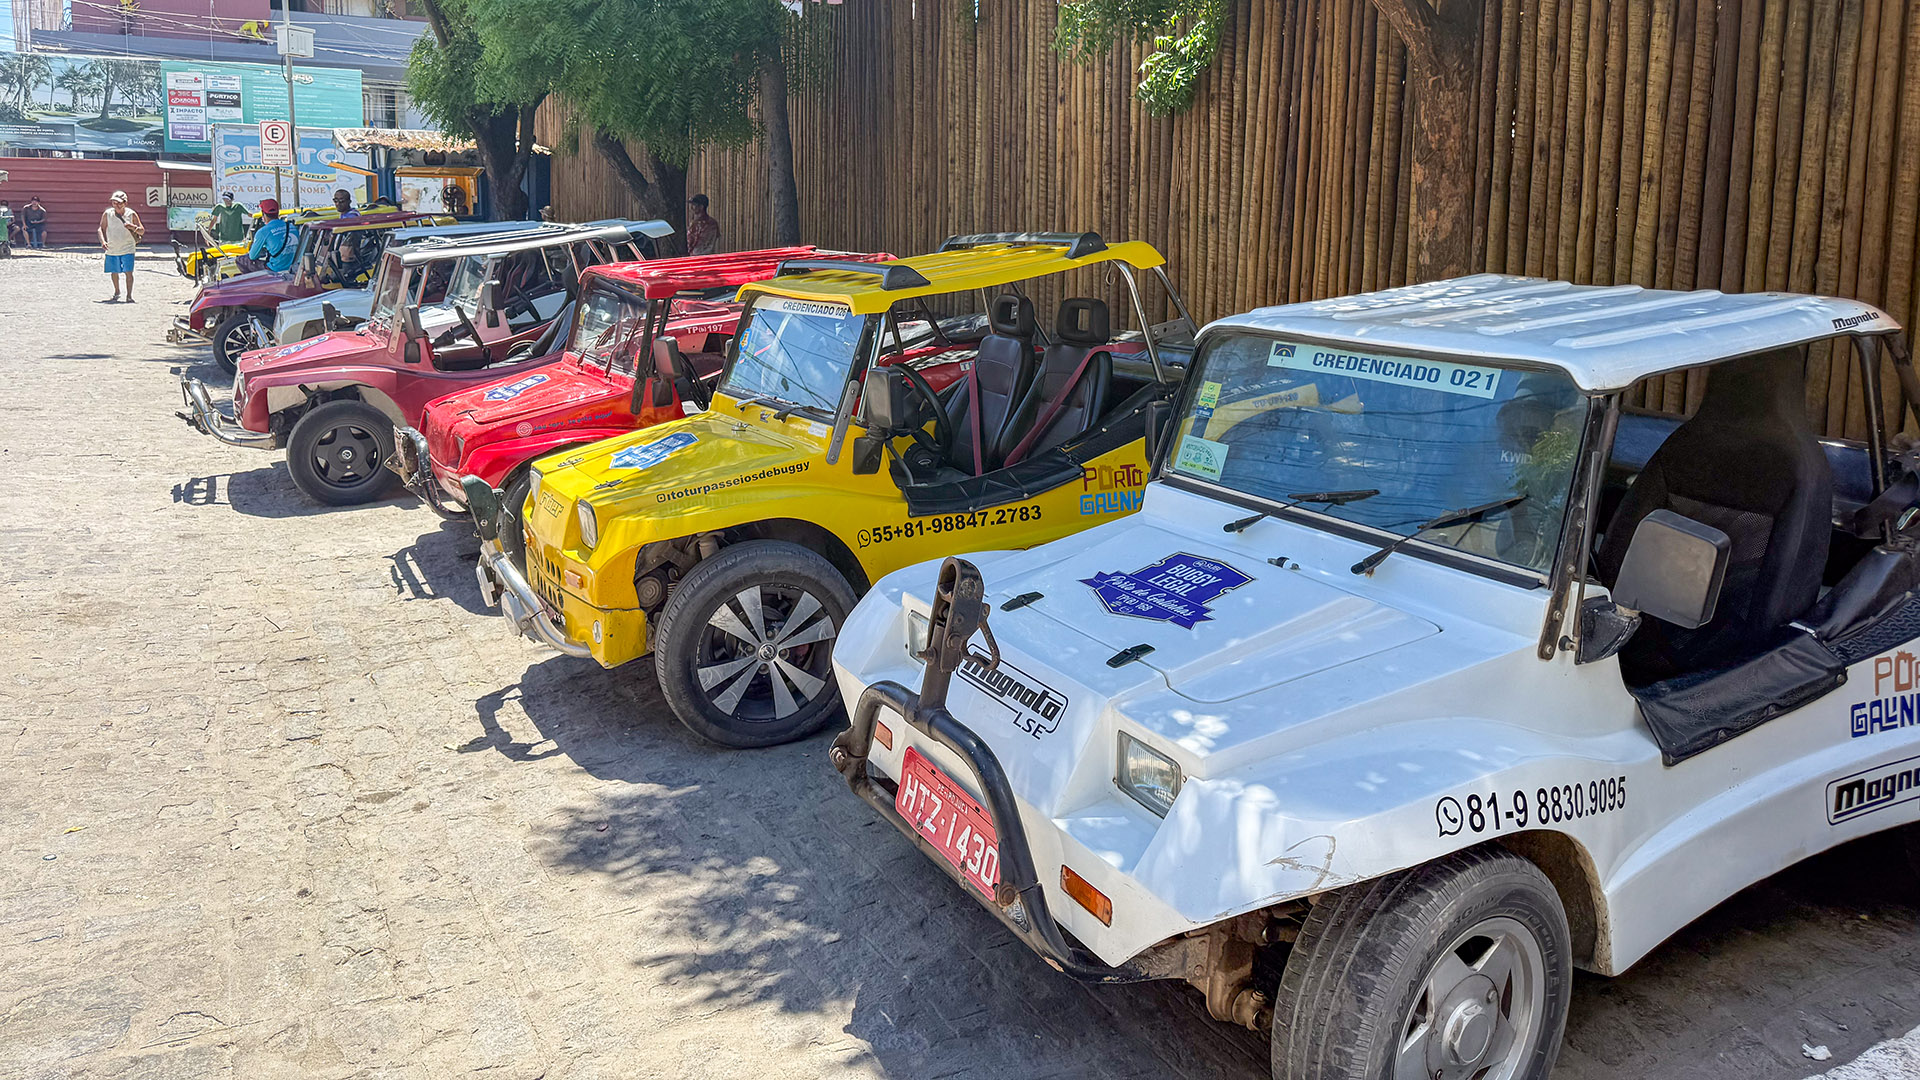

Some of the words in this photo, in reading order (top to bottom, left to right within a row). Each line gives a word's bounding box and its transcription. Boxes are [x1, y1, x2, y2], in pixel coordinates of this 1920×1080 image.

[271, 128, 279, 139] E
[171, 192, 208, 201] ADANO
[247, 185, 271, 193] GELO
[300, 186, 326, 194] NOME
[782, 300, 834, 316] CREDENCIADO
[1312, 352, 1441, 383] CREDENCIADO
[1450, 368, 1495, 391] 021
[1083, 463, 1143, 492] PORTO
[872, 505, 1042, 543] 55+81-98847.2783
[1148, 573, 1197, 596] LEGAL
[1166, 563, 1222, 588] BUGGY
[1874, 650, 1920, 696] PO
[1012, 711, 1047, 740] LSE
[1850, 693, 1920, 738] GALIN
[1466, 790, 1529, 833] 81-9
[1536, 775, 1626, 825] 8830.9095
